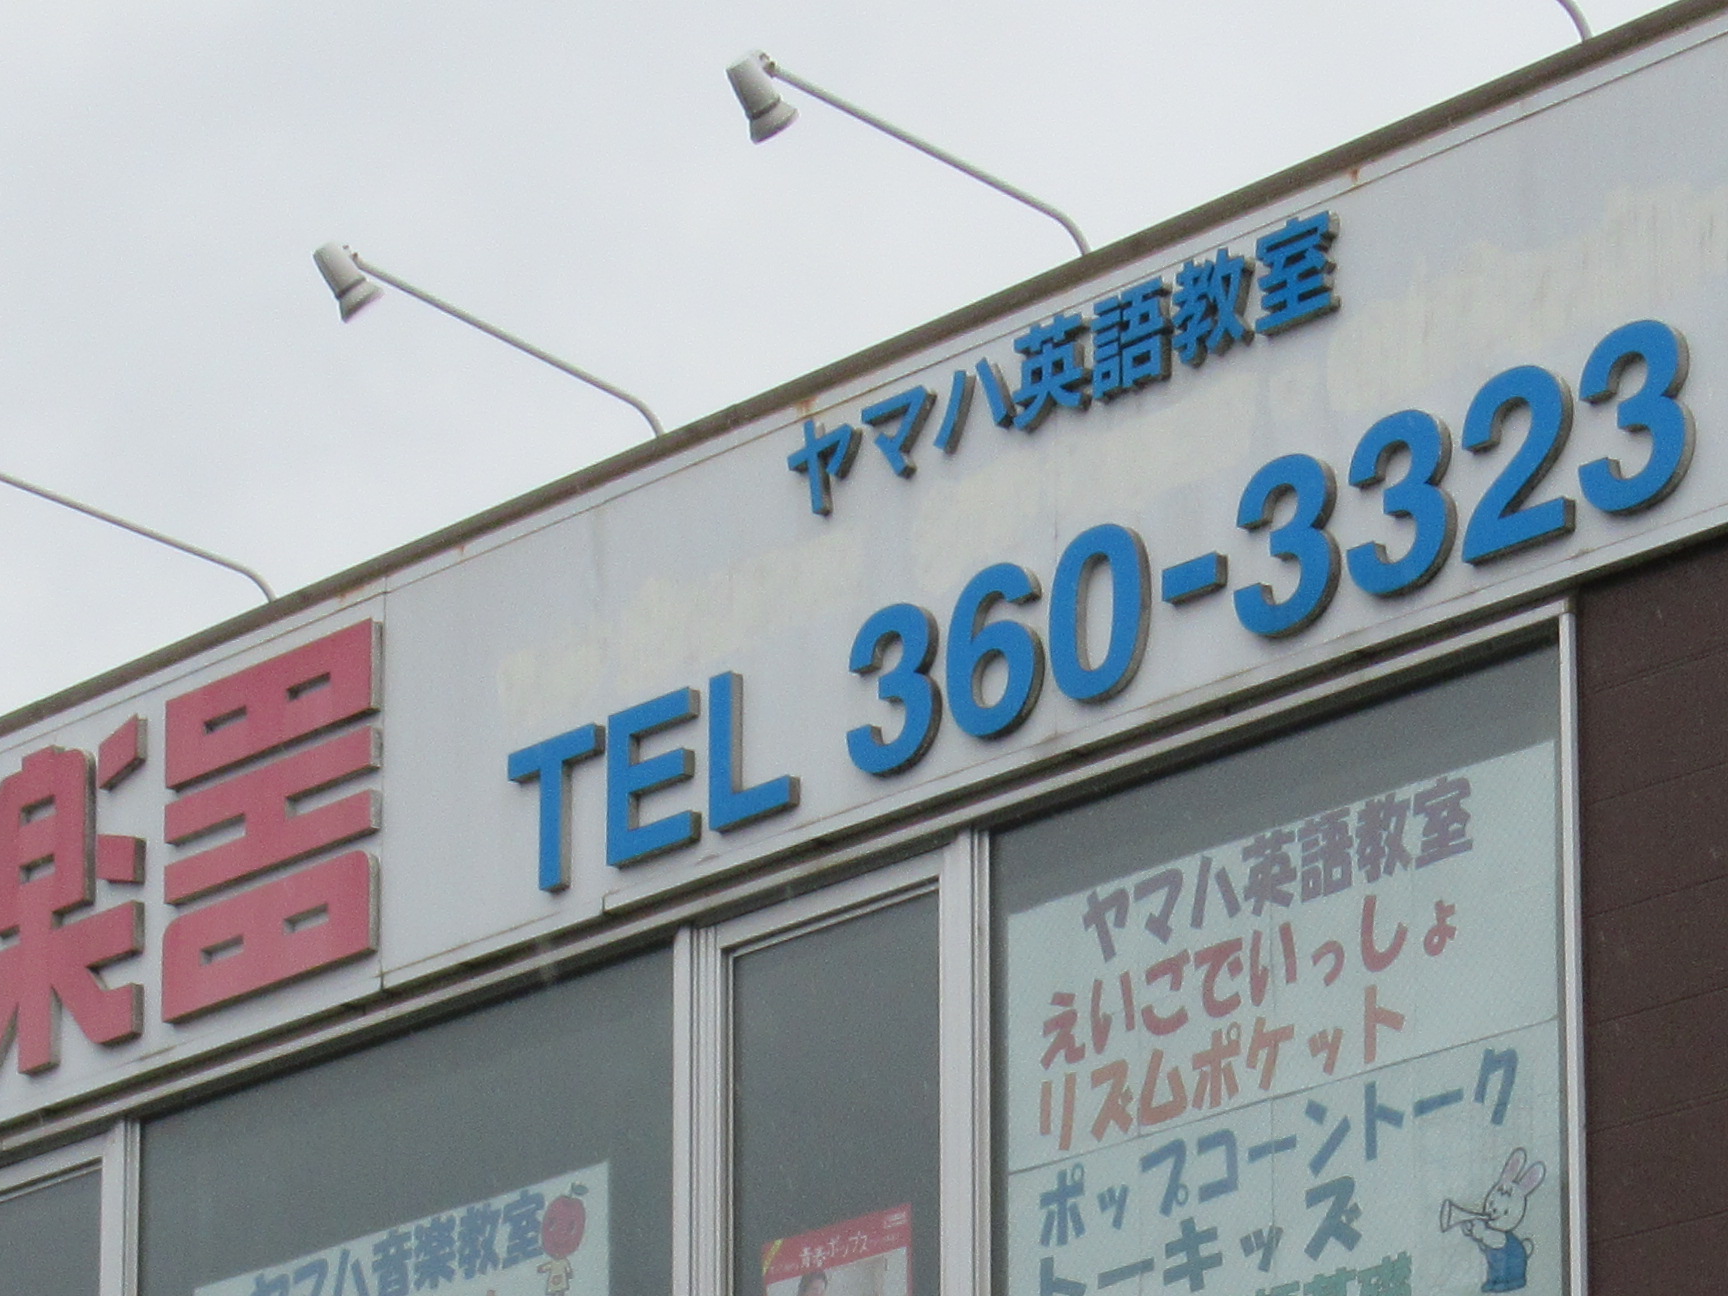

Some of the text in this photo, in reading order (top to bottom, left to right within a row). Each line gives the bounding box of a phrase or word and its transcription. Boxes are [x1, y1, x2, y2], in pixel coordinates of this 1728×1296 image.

[787, 209, 1341, 517] ヤマハ英語教室
[507, 318, 1695, 892] TEL 360-3323
[1082, 775, 1474, 962] ヤマハ英語教室
[1039, 985, 1405, 1152] リズムポケット
[1040, 895, 1458, 1069] えいごでいっしょ
[1039, 1047, 1518, 1247] ポップコーントーク
